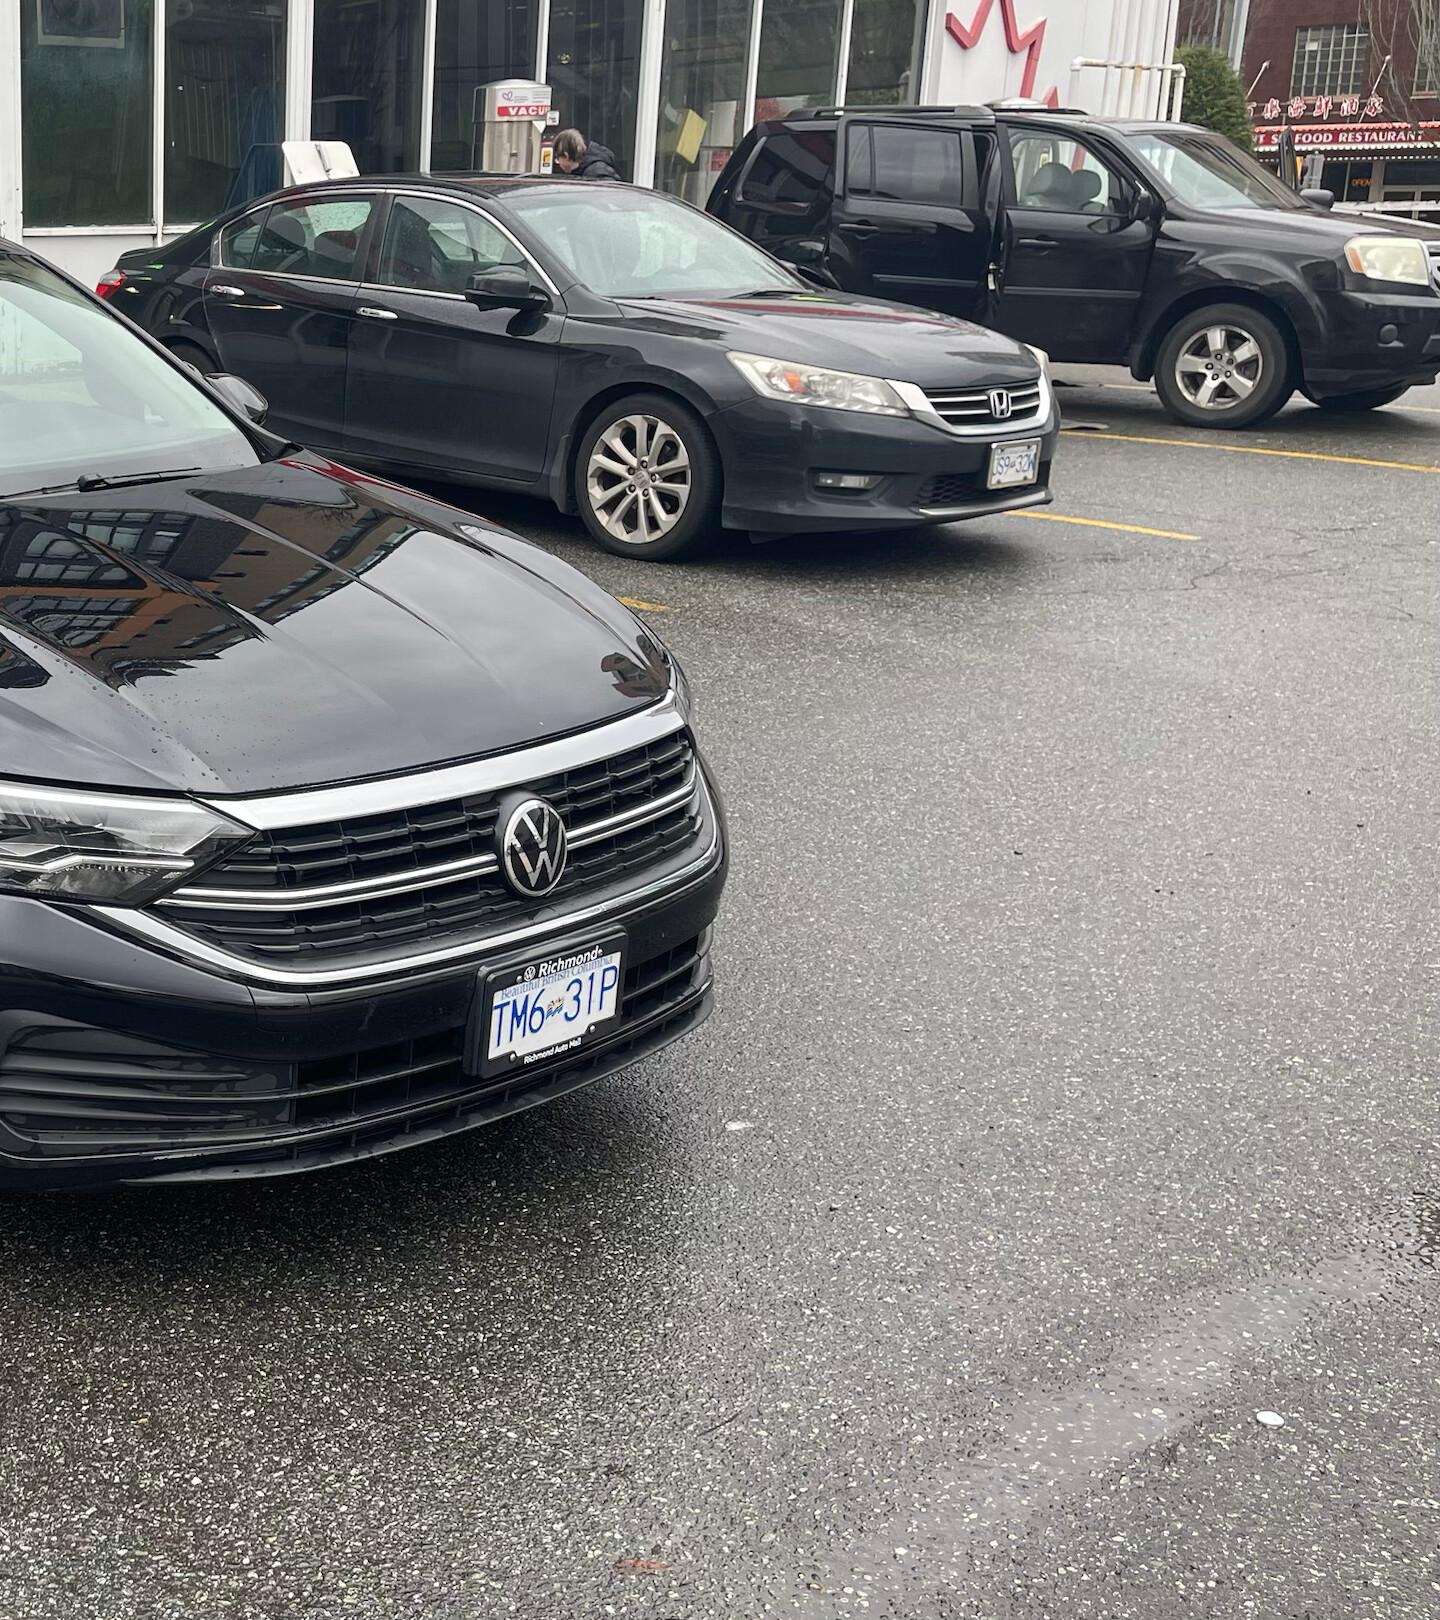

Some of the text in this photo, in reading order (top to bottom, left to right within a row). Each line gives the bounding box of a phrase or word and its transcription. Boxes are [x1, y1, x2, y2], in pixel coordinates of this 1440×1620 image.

[1339, 131, 1424, 142] RESTAURANT
[538, 945, 599, 978] Richmond
[494, 965, 618, 1048] TM6 31P
[523, 1037, 582, 1064] Richmond Auto Mall
